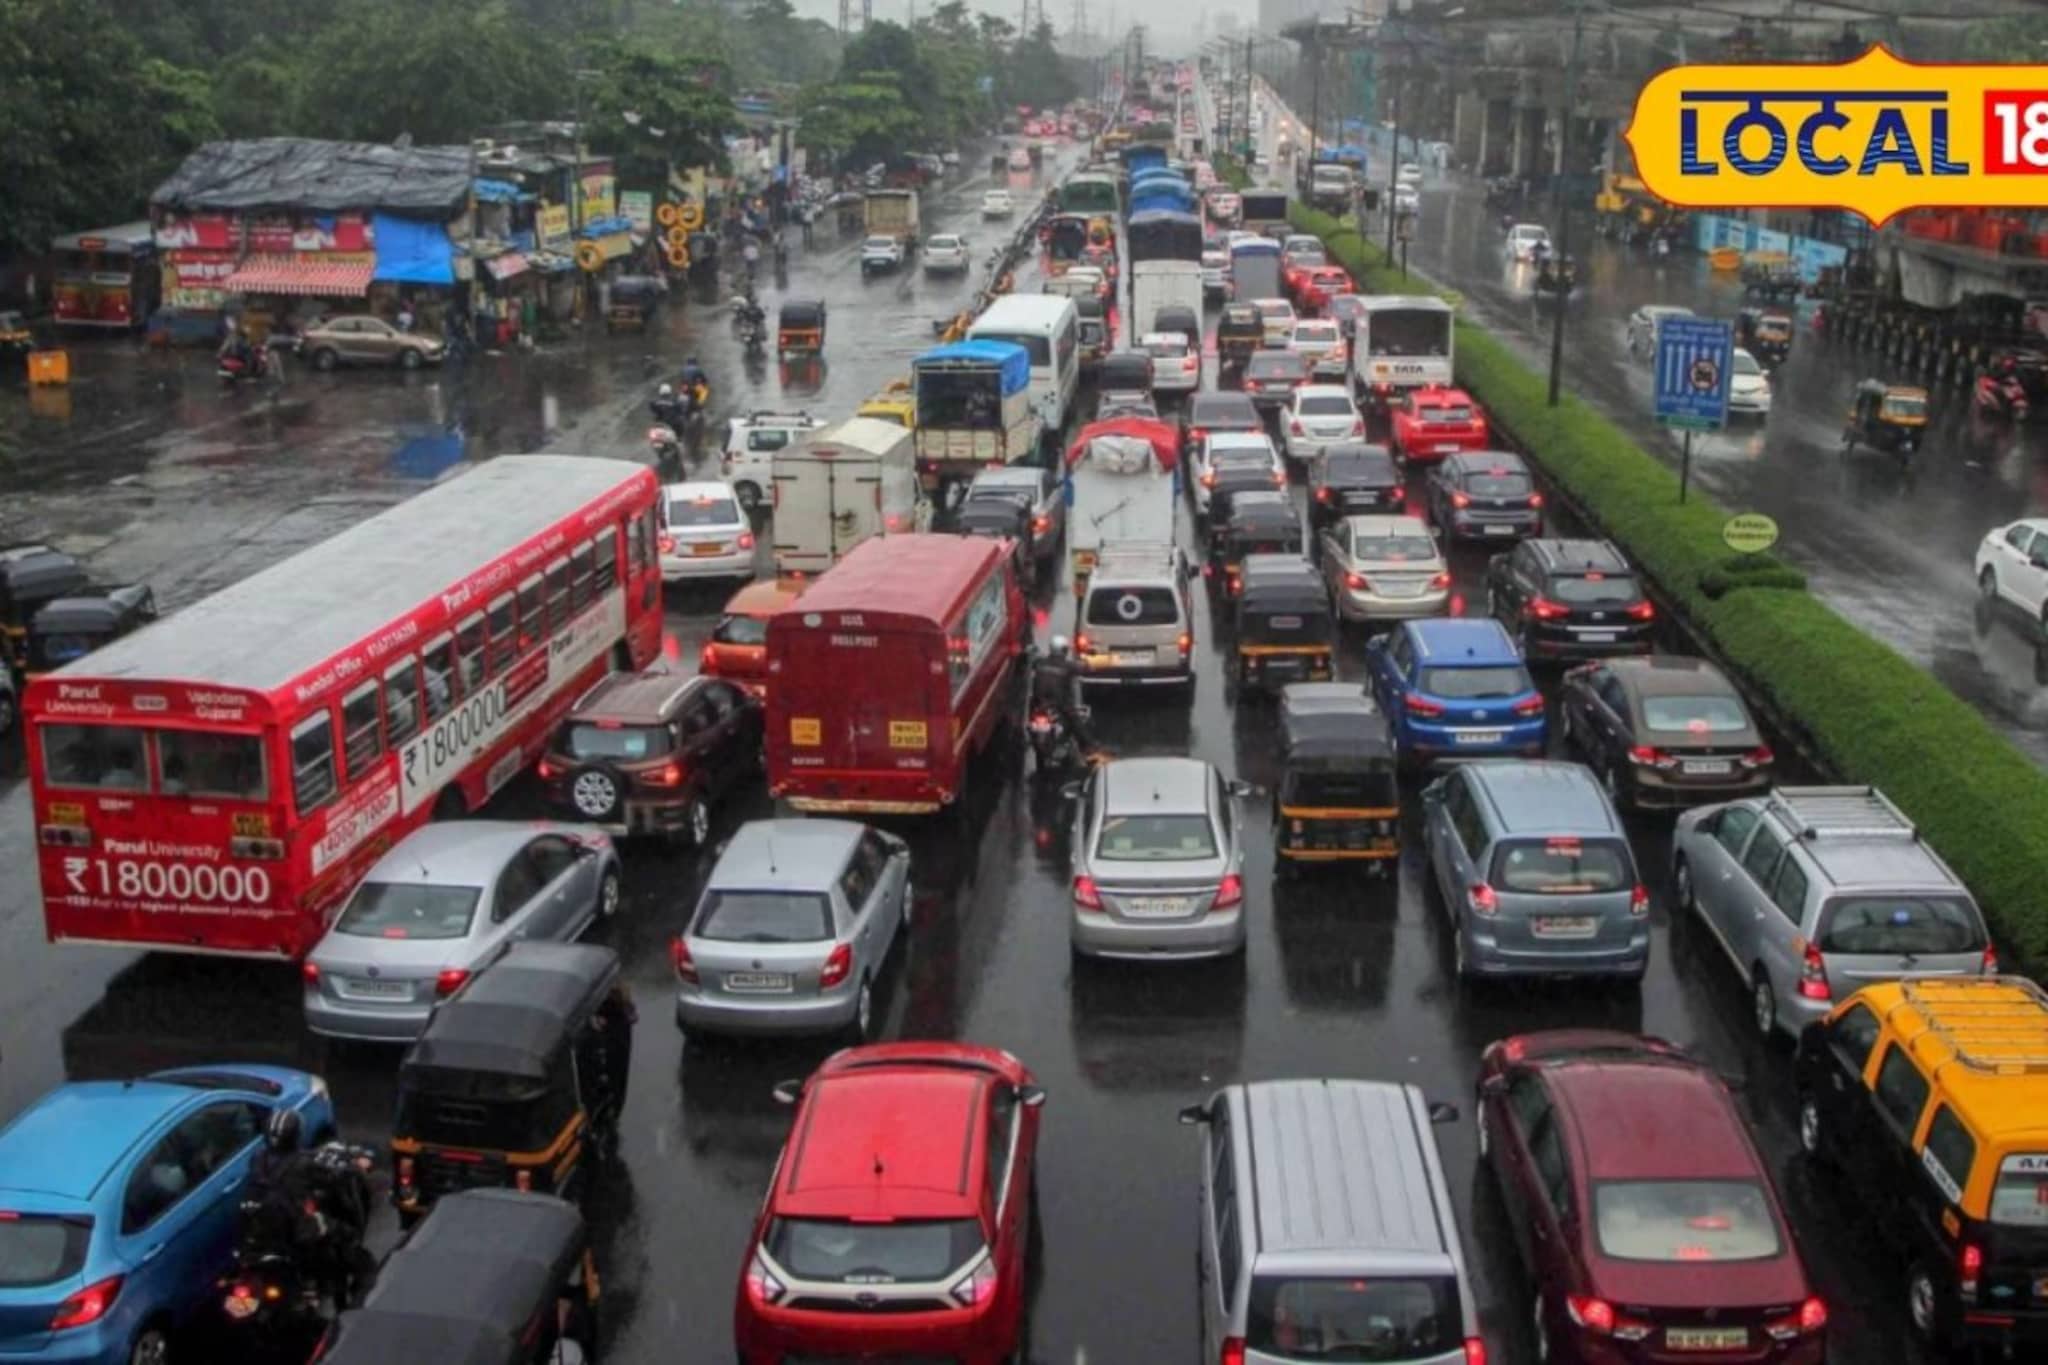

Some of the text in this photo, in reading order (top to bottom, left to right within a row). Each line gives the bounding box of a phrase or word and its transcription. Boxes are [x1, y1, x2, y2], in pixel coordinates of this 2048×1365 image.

[58, 683, 100, 699] Parul
[45, 700, 115, 718] University
[104, 838, 222, 861] Parul University
